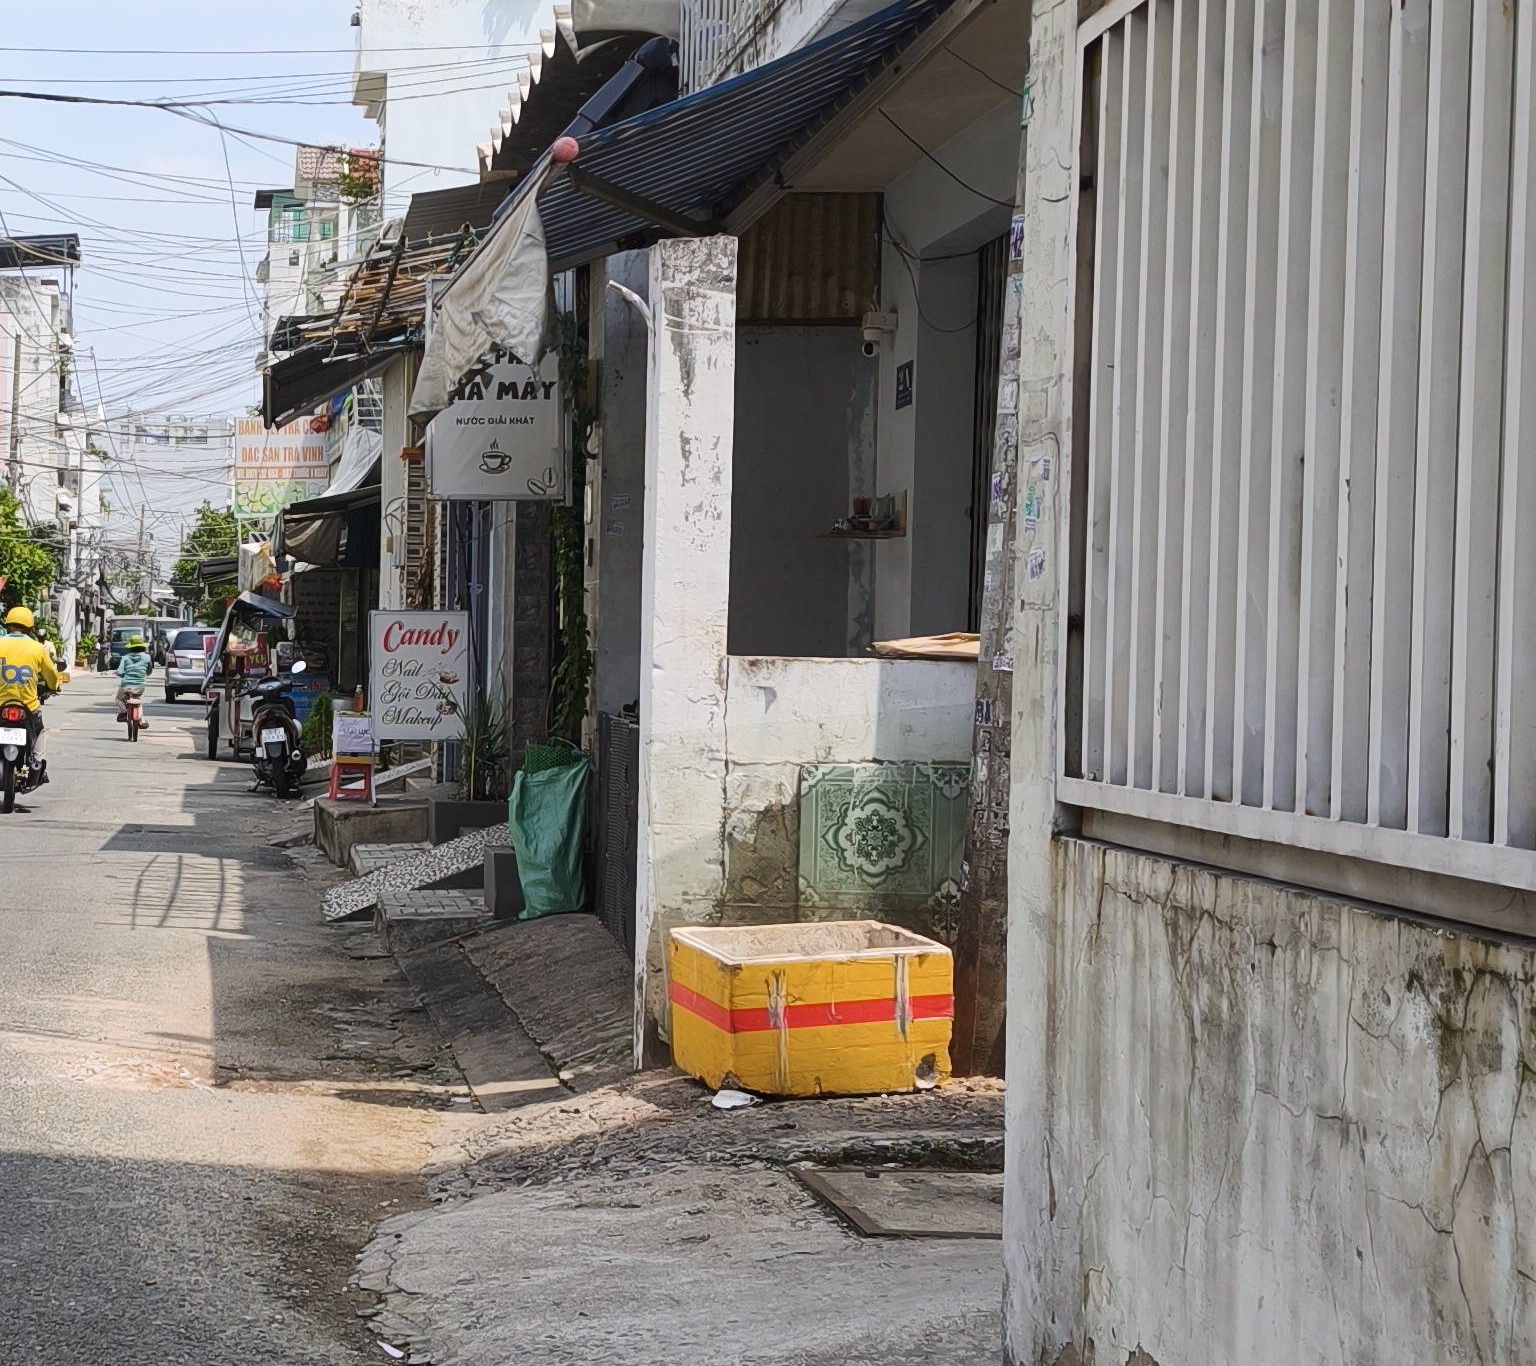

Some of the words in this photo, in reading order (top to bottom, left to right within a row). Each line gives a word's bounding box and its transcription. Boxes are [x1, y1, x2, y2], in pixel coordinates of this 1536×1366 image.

[496, 376, 558, 401] MÁY
[456, 416, 486, 426] NƯỚC
[487, 414, 507, 425] GIẢI
[509, 415, 536, 425] KHÁT
[302, 445, 324, 462] VINH
[383, 620, 460, 655] Candy
[1, 657, 33, 686] be
[382, 657, 423, 678] Nail
[382, 705, 443, 732] Makeup
